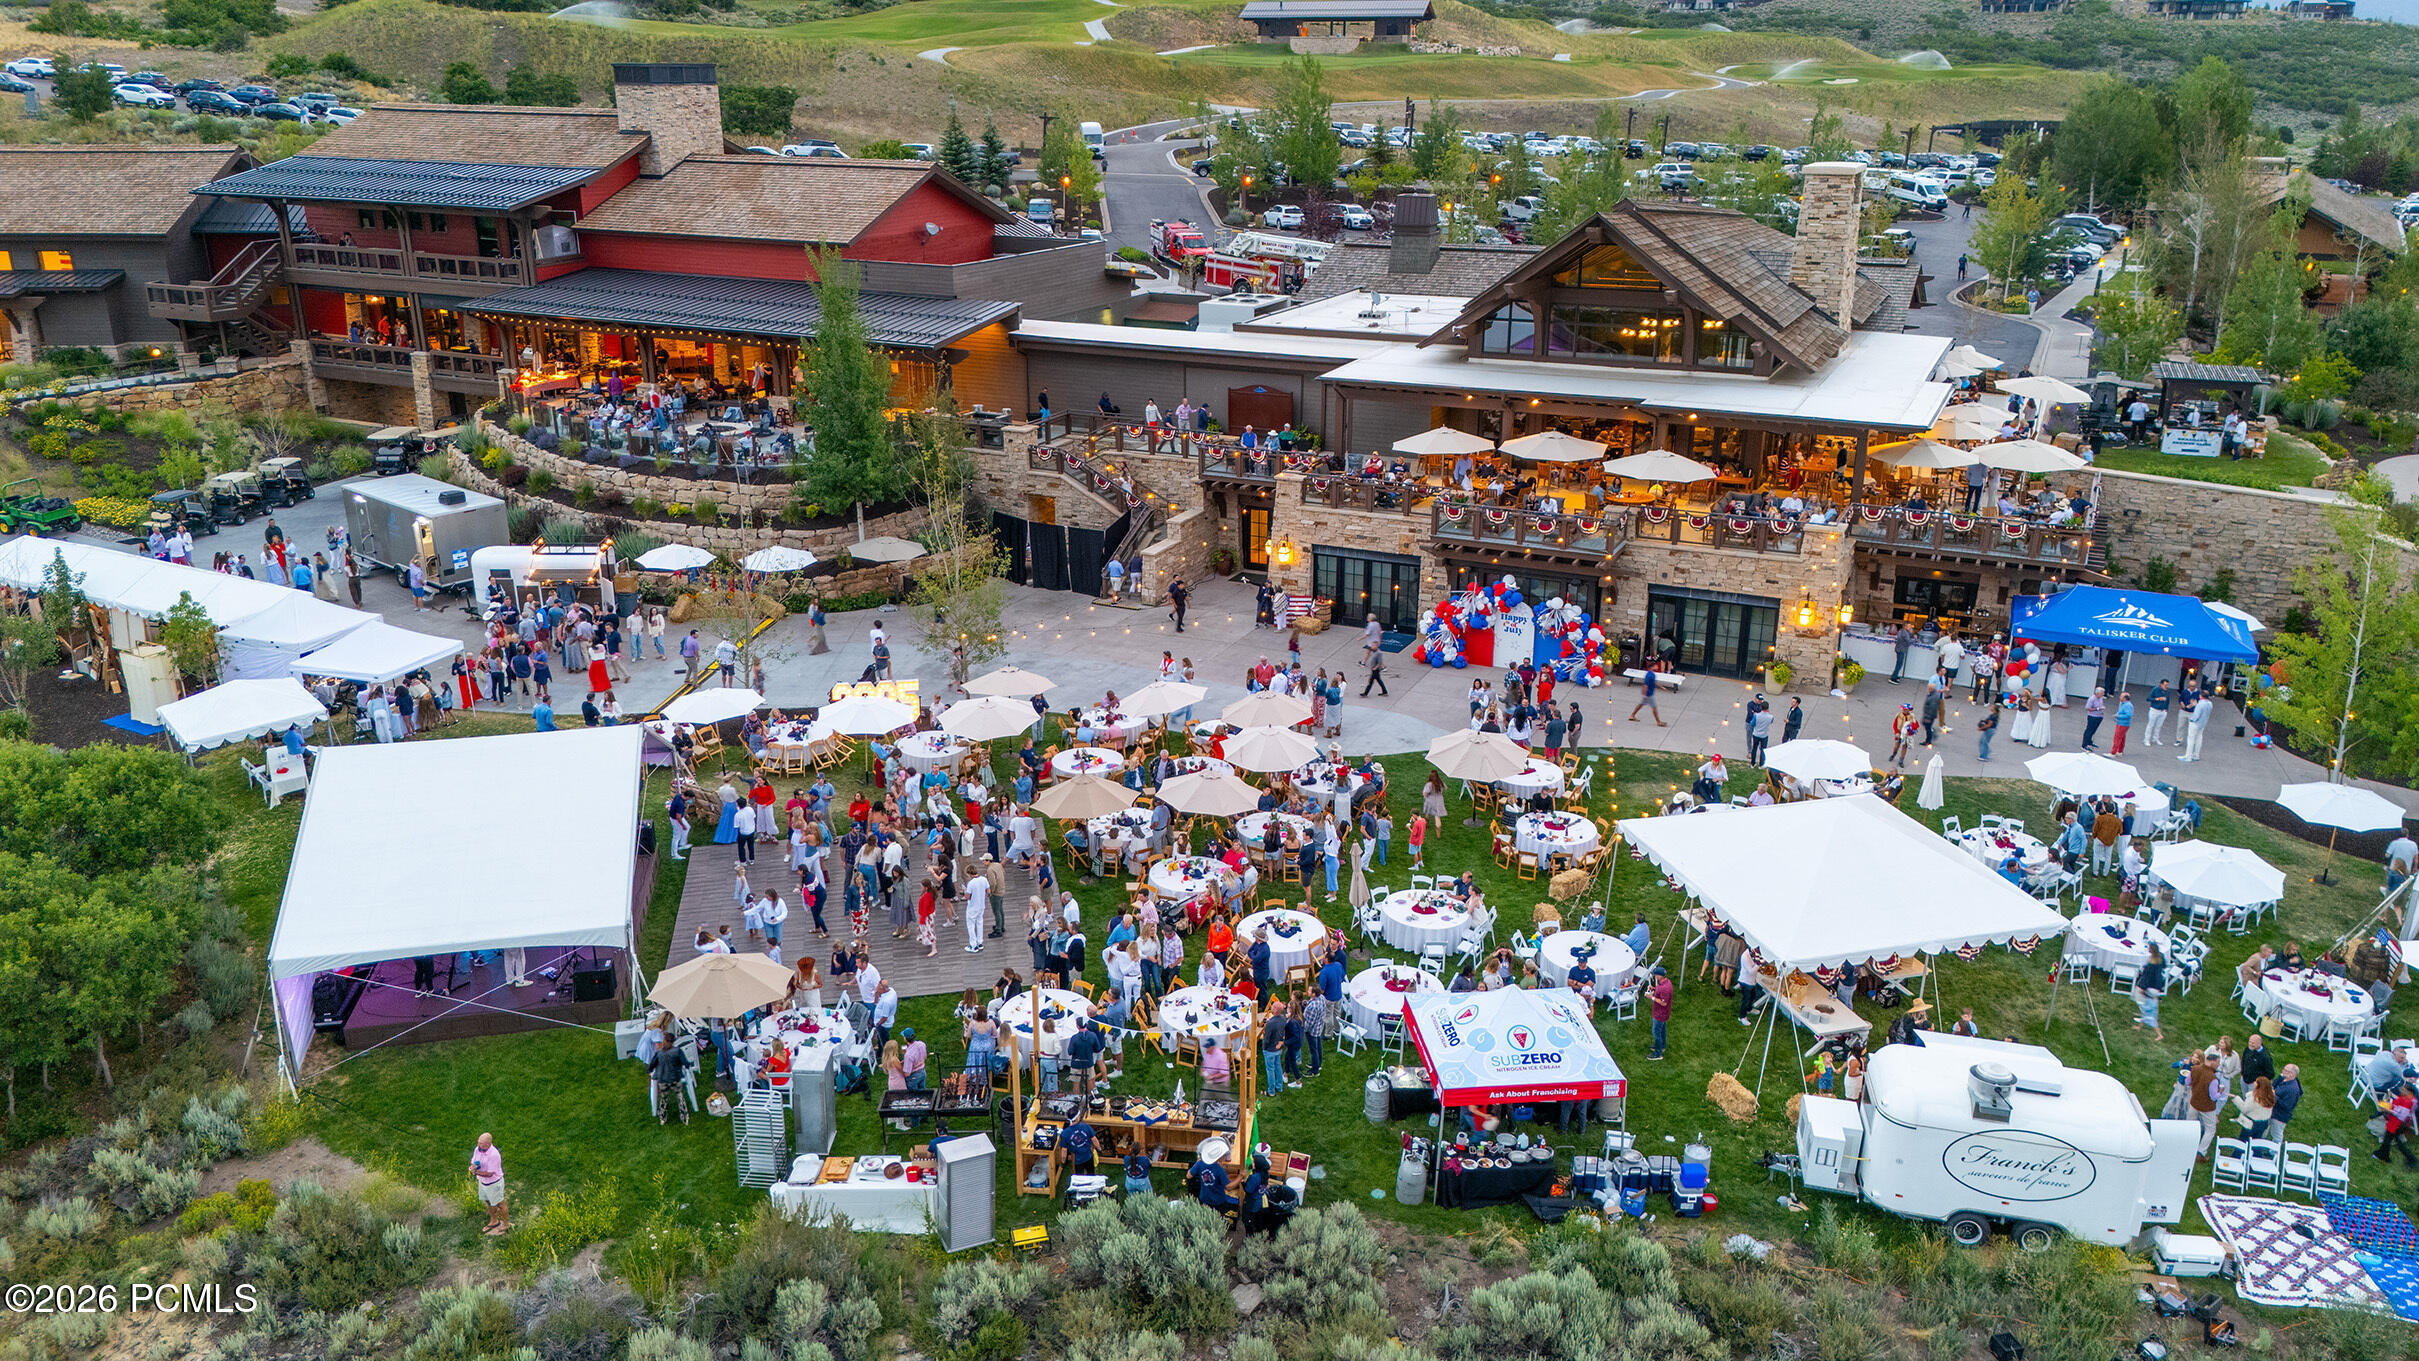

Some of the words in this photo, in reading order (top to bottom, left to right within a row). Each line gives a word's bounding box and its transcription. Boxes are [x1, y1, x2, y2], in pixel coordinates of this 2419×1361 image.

[1501, 614, 1527, 625] Happy
[1504, 627, 1522, 636] July
[2078, 627, 2147, 640] TALISKER
[2150, 634, 2189, 646] CLUB
[1490, 1052, 1562, 1067] SUBZERO
[1496, 1065, 1528, 1073] NITROGEN
[1489, 1091, 1504, 1099] Ask
[1506, 1090, 1530, 1098] About
[1532, 1088, 1578, 1097] Franchising
[1961, 1145, 2077, 1176] Franck's
[2016, 1173, 2031, 1183] de
